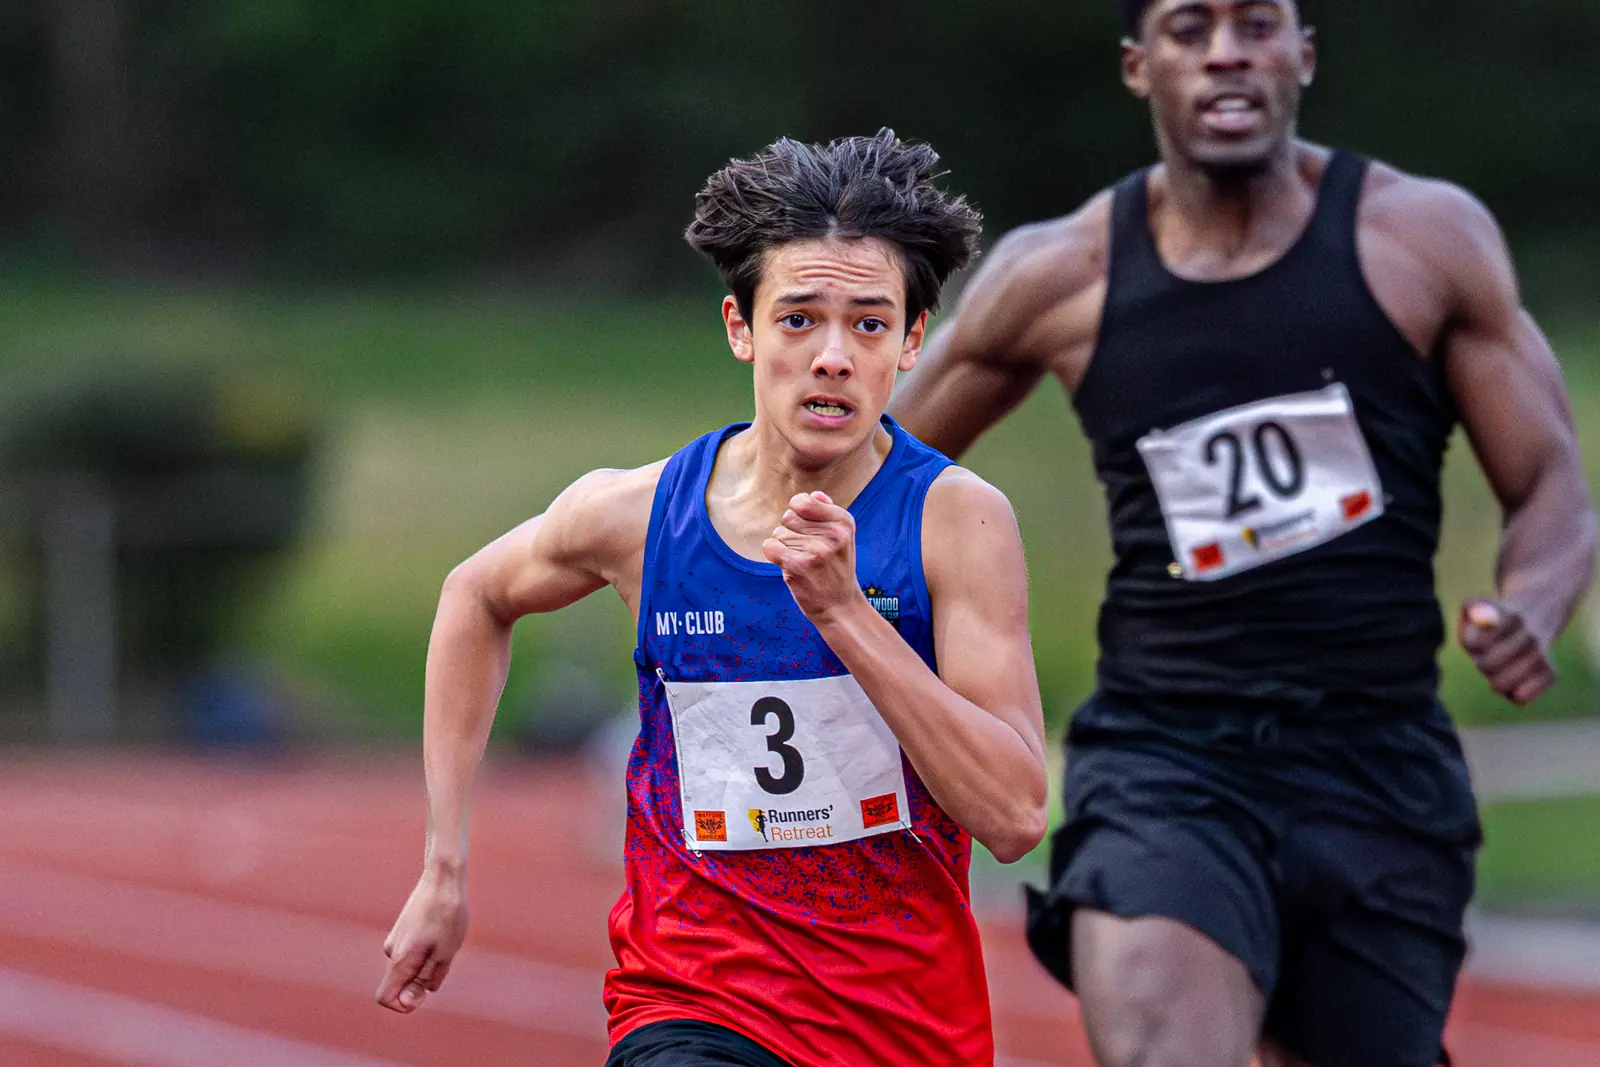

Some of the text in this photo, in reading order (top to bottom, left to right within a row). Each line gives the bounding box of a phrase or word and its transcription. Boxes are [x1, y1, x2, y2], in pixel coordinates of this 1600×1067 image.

[1204, 420, 1305, 521] 20
[867, 597, 899, 611] TWOOD
[750, 696, 805, 795] 3
[770, 824, 834, 841] Retreat
